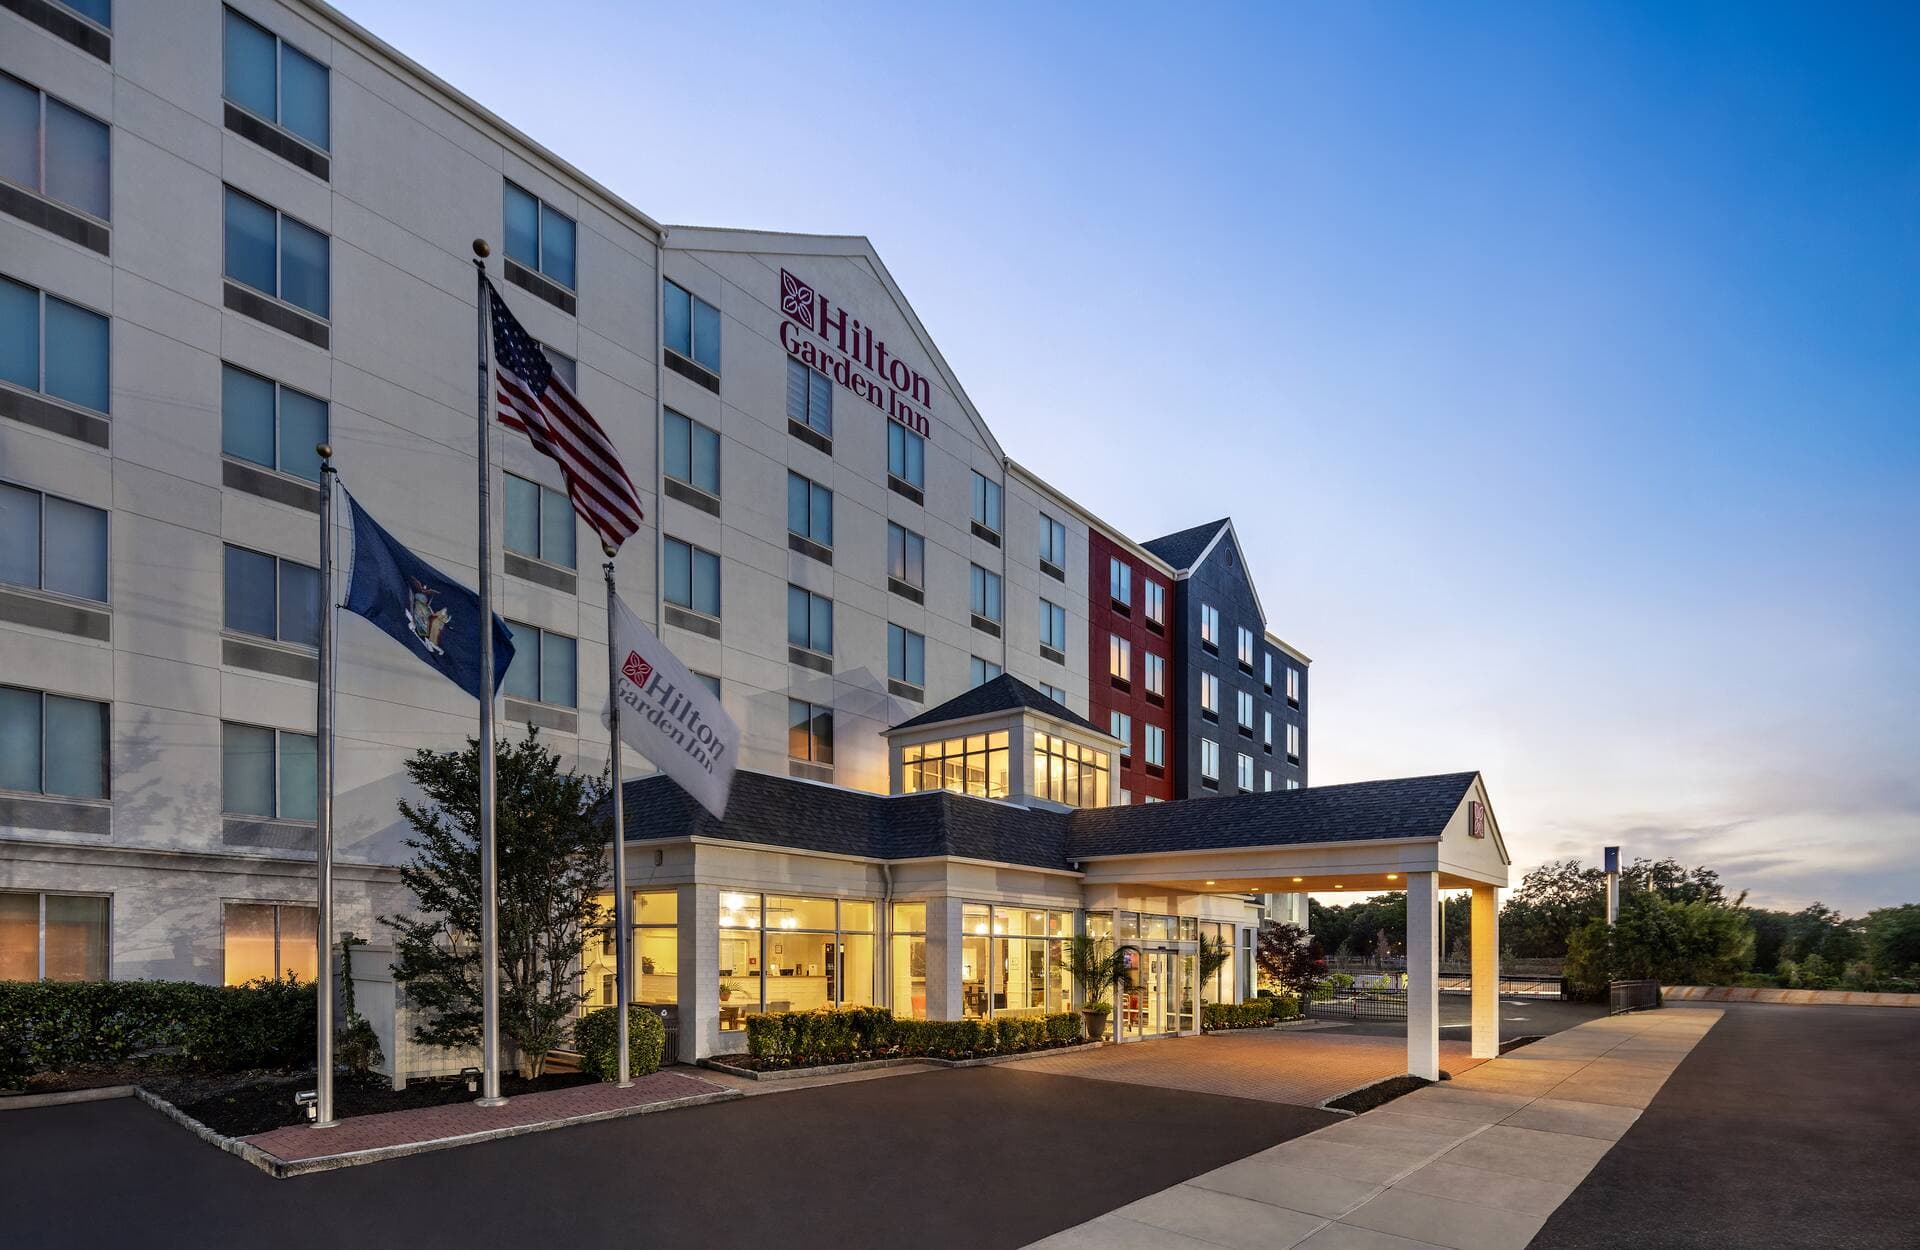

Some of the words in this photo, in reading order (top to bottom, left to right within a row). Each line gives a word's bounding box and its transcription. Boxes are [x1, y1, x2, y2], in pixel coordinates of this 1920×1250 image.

[780, 320, 884, 410] Garden
[888, 387, 931, 440] Inn
[818, 294, 931, 409] Hilton
[618, 677, 685, 745] Garden
[683, 738, 714, 775] Inn
[646, 671, 725, 760] Hilton
